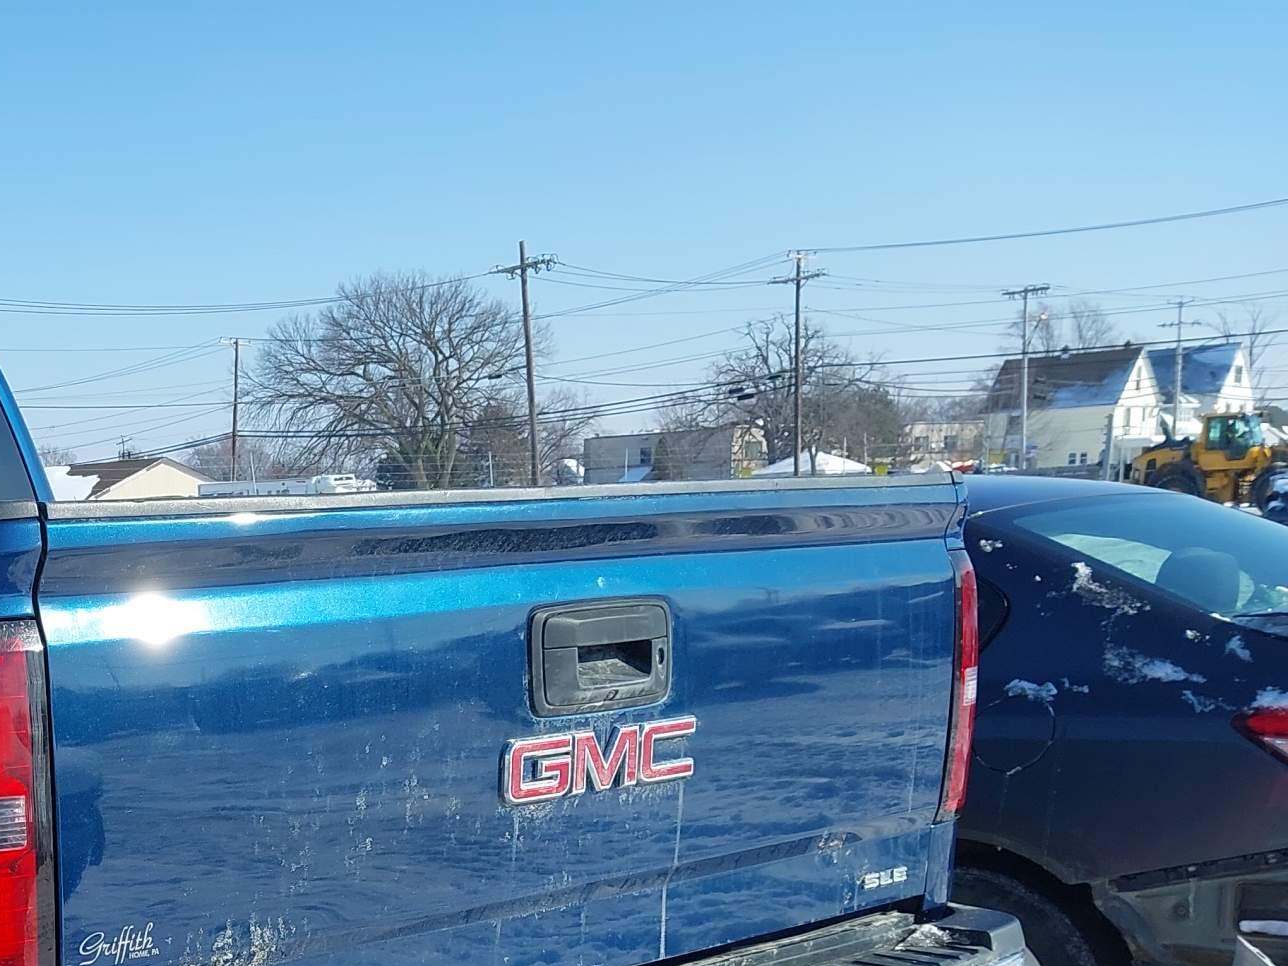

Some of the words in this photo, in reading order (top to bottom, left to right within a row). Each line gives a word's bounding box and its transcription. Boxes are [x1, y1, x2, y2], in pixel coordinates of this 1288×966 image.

[500, 715, 697, 804] GMC
[863, 866, 908, 889] SLE
[79, 922, 154, 966] Griffith
